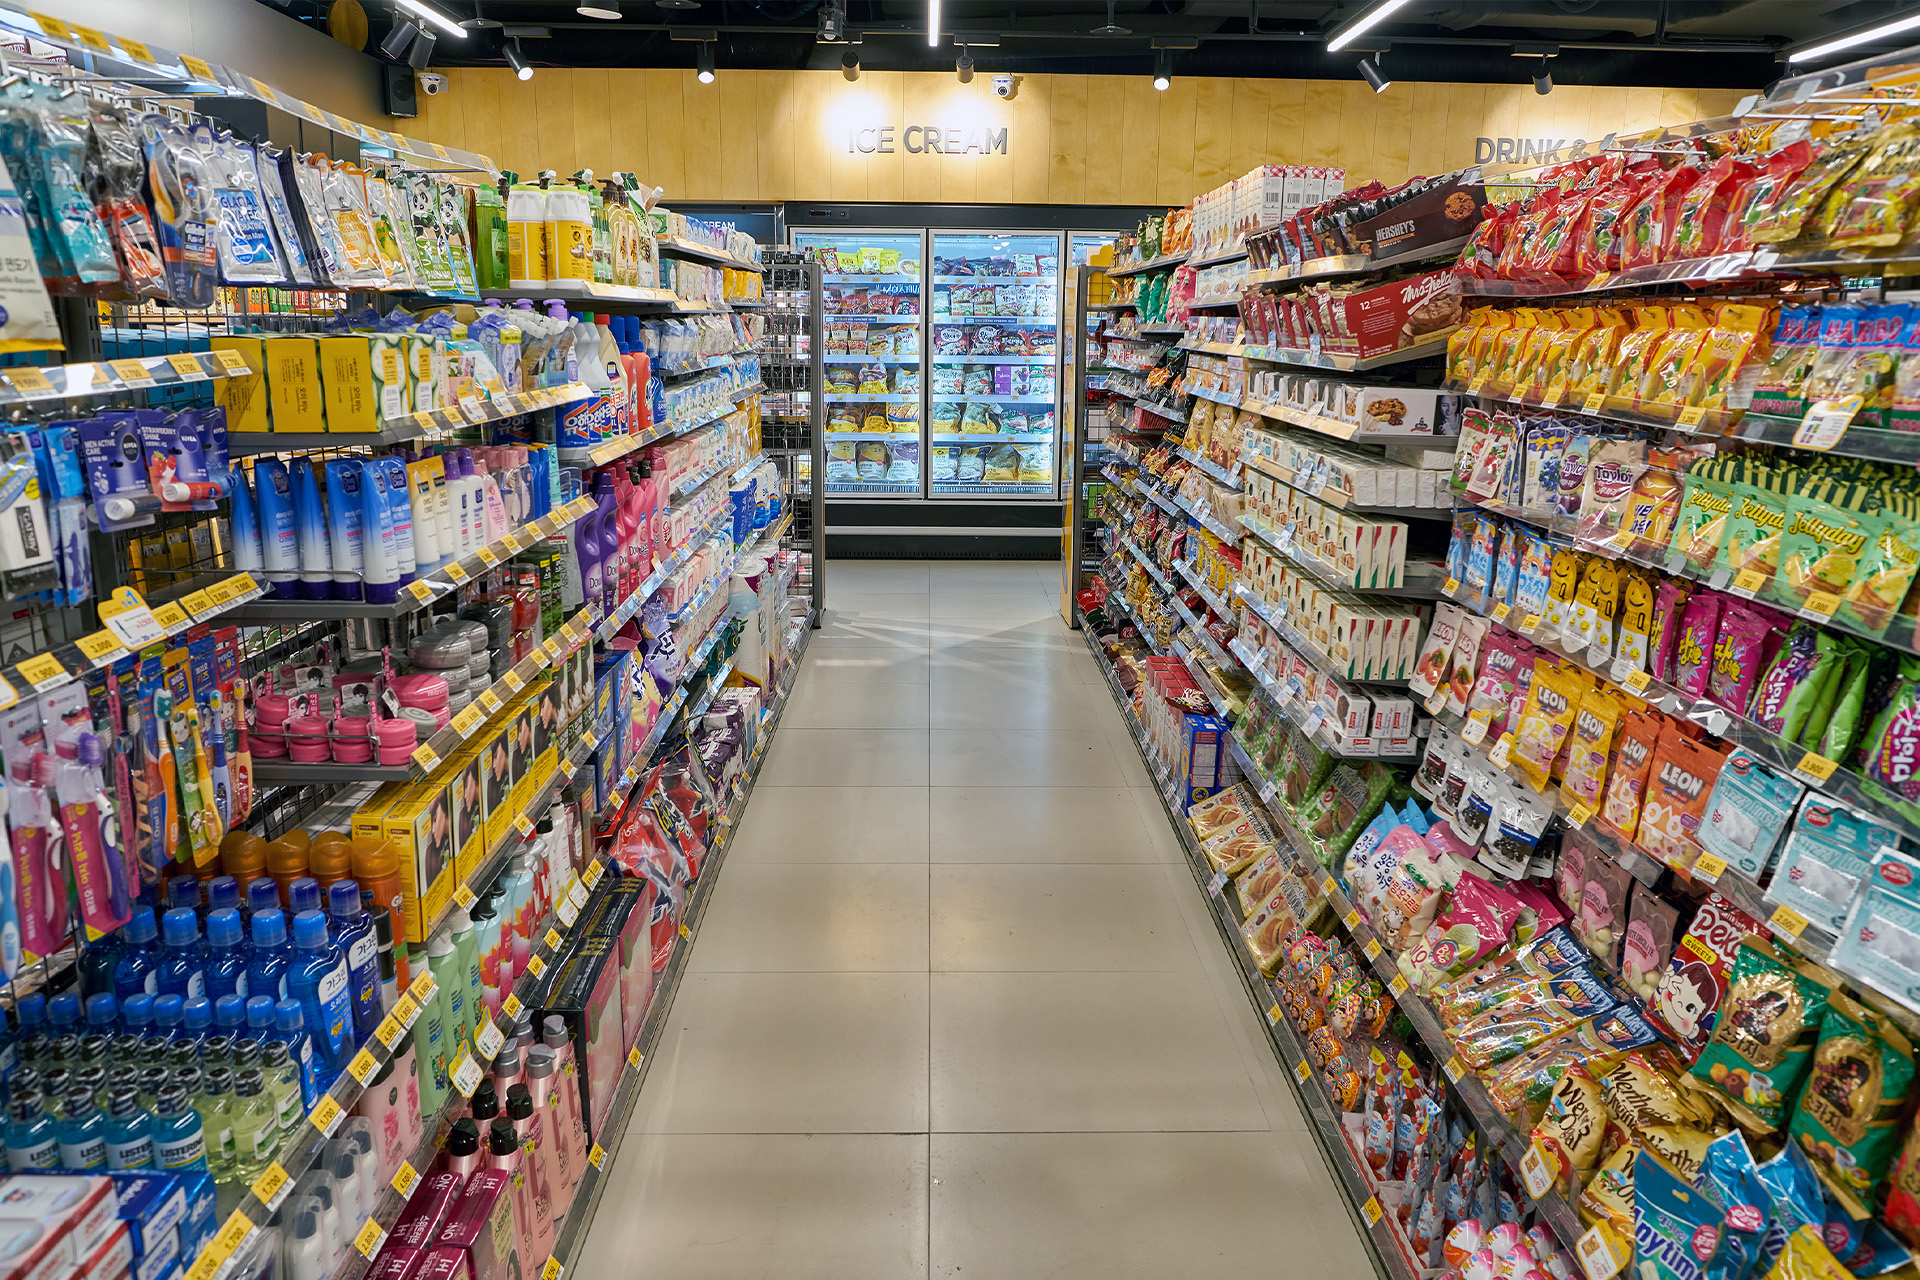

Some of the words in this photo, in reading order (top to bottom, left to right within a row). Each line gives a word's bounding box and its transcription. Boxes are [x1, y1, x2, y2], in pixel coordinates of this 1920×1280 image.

[849, 126, 894, 153] ICE
[903, 125, 1007, 155] CREAM
[1475, 137, 1565, 164] DRINK
[1568, 138, 1590, 160] &
[220, 196, 258, 208] GLACIAL
[1375, 219, 1415, 242] HERSHEY'S
[1359, 301, 1371, 311] 12
[1823, 316, 1903, 344] HARIBO
[299, 386, 308, 400] 오이
[353, 386, 362, 400] 오이
[300, 400, 308, 413] 비누
[354, 400, 363, 413] 비누
[141, 426, 176, 436] STRAWBERRY
[564, 414, 588, 435] 유한
[84, 440, 98, 449] MEN
[98, 439, 116, 448] ACTIVE
[123, 442, 138, 450] NIVEA
[181, 434, 197, 442] NIVEA
[85, 447, 101, 455] CARE
[1595, 465, 1634, 484] Taylor
[1788, 510, 1868, 555] Jellyday
[121, 590, 139, 608] 1+1
[189, 601, 207, 614] 3,000
[1637, 612, 1645, 632] Q
[89, 639, 112, 653] 3,000
[1488, 649, 1516, 671] LEON
[1537, 685, 1568, 713] LEON
[1576, 708, 1605, 739] LEON
[1622, 734, 1649, 765] LEON
[1657, 760, 1704, 800] LEON
[1775, 914, 1797, 931] 2,000
[356, 934, 378, 956] 가그린
[1435, 943, 1450, 964] Bio
[1685, 938, 1713, 963] SWEETS
[325, 969, 347, 991] 가그린
[384, 1026, 396, 1042] 4,500
[1715, 1029, 1758, 1061] 스카치
[357, 1060, 371, 1077] 4,500
[319, 1107, 336, 1127] 1,700
[164, 1154, 187, 1164] COOL
[1545, 1154, 1557, 1179] SALE
[262, 1174, 281, 1195] 1,700
[398, 1172, 412, 1189] 4,500
[224, 1227, 244, 1251] 1,700
[361, 1230, 376, 1249] 2,800
[1609, 1241, 1626, 1268] SALE
